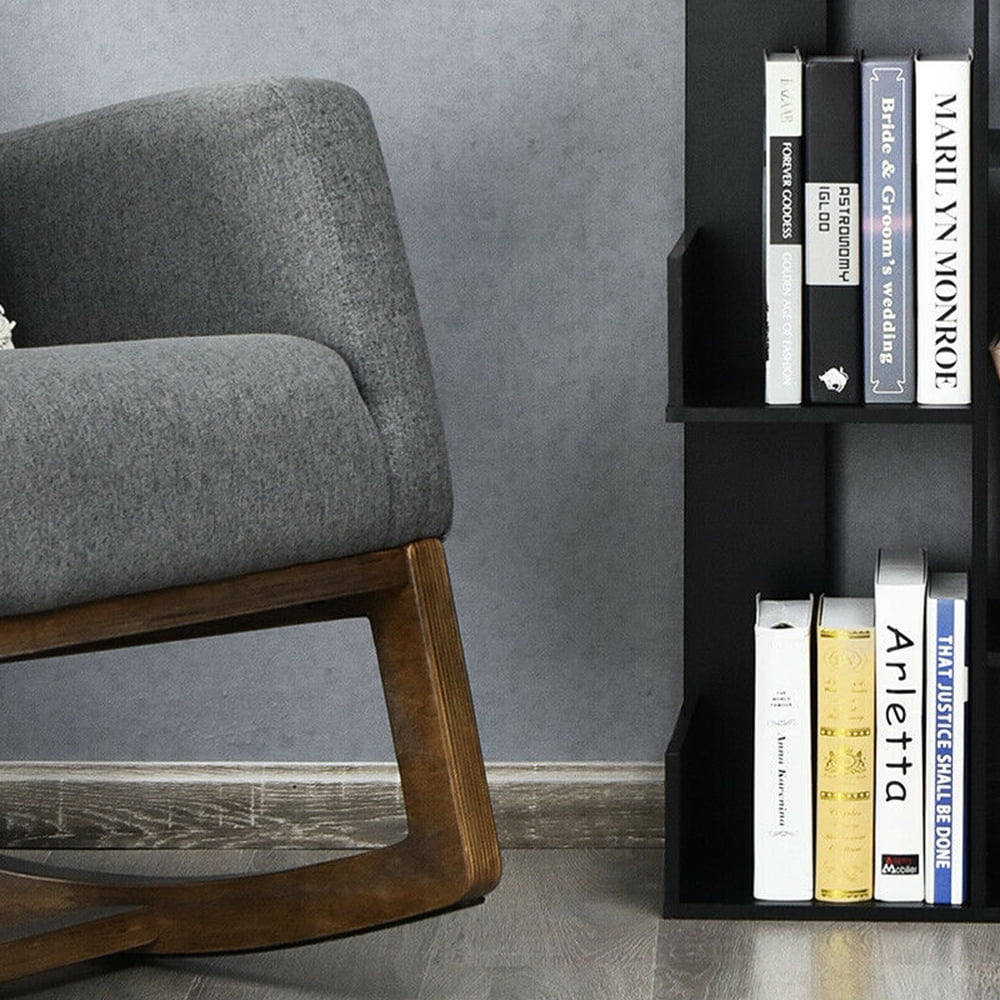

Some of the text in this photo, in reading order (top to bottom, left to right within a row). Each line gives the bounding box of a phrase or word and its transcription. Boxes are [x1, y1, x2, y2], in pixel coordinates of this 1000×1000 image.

[782, 142, 792, 239] FOREVER GODDESS
[819, 186, 830, 232] IGLOO
[839, 186, 851, 282] ASTRONOMY
[879, 97, 896, 365] Bride & Groom's wedding
[782, 252, 793, 296] GOLDEN
[934, 94, 957, 389] MARILYN MONROE
[782, 300, 793, 320] AGE
[782, 340, 793, 385] FASHION
[886, 626, 916, 802] Arletta
[936, 635, 954, 869] THAT JUSTICE SHALL BE DONE
